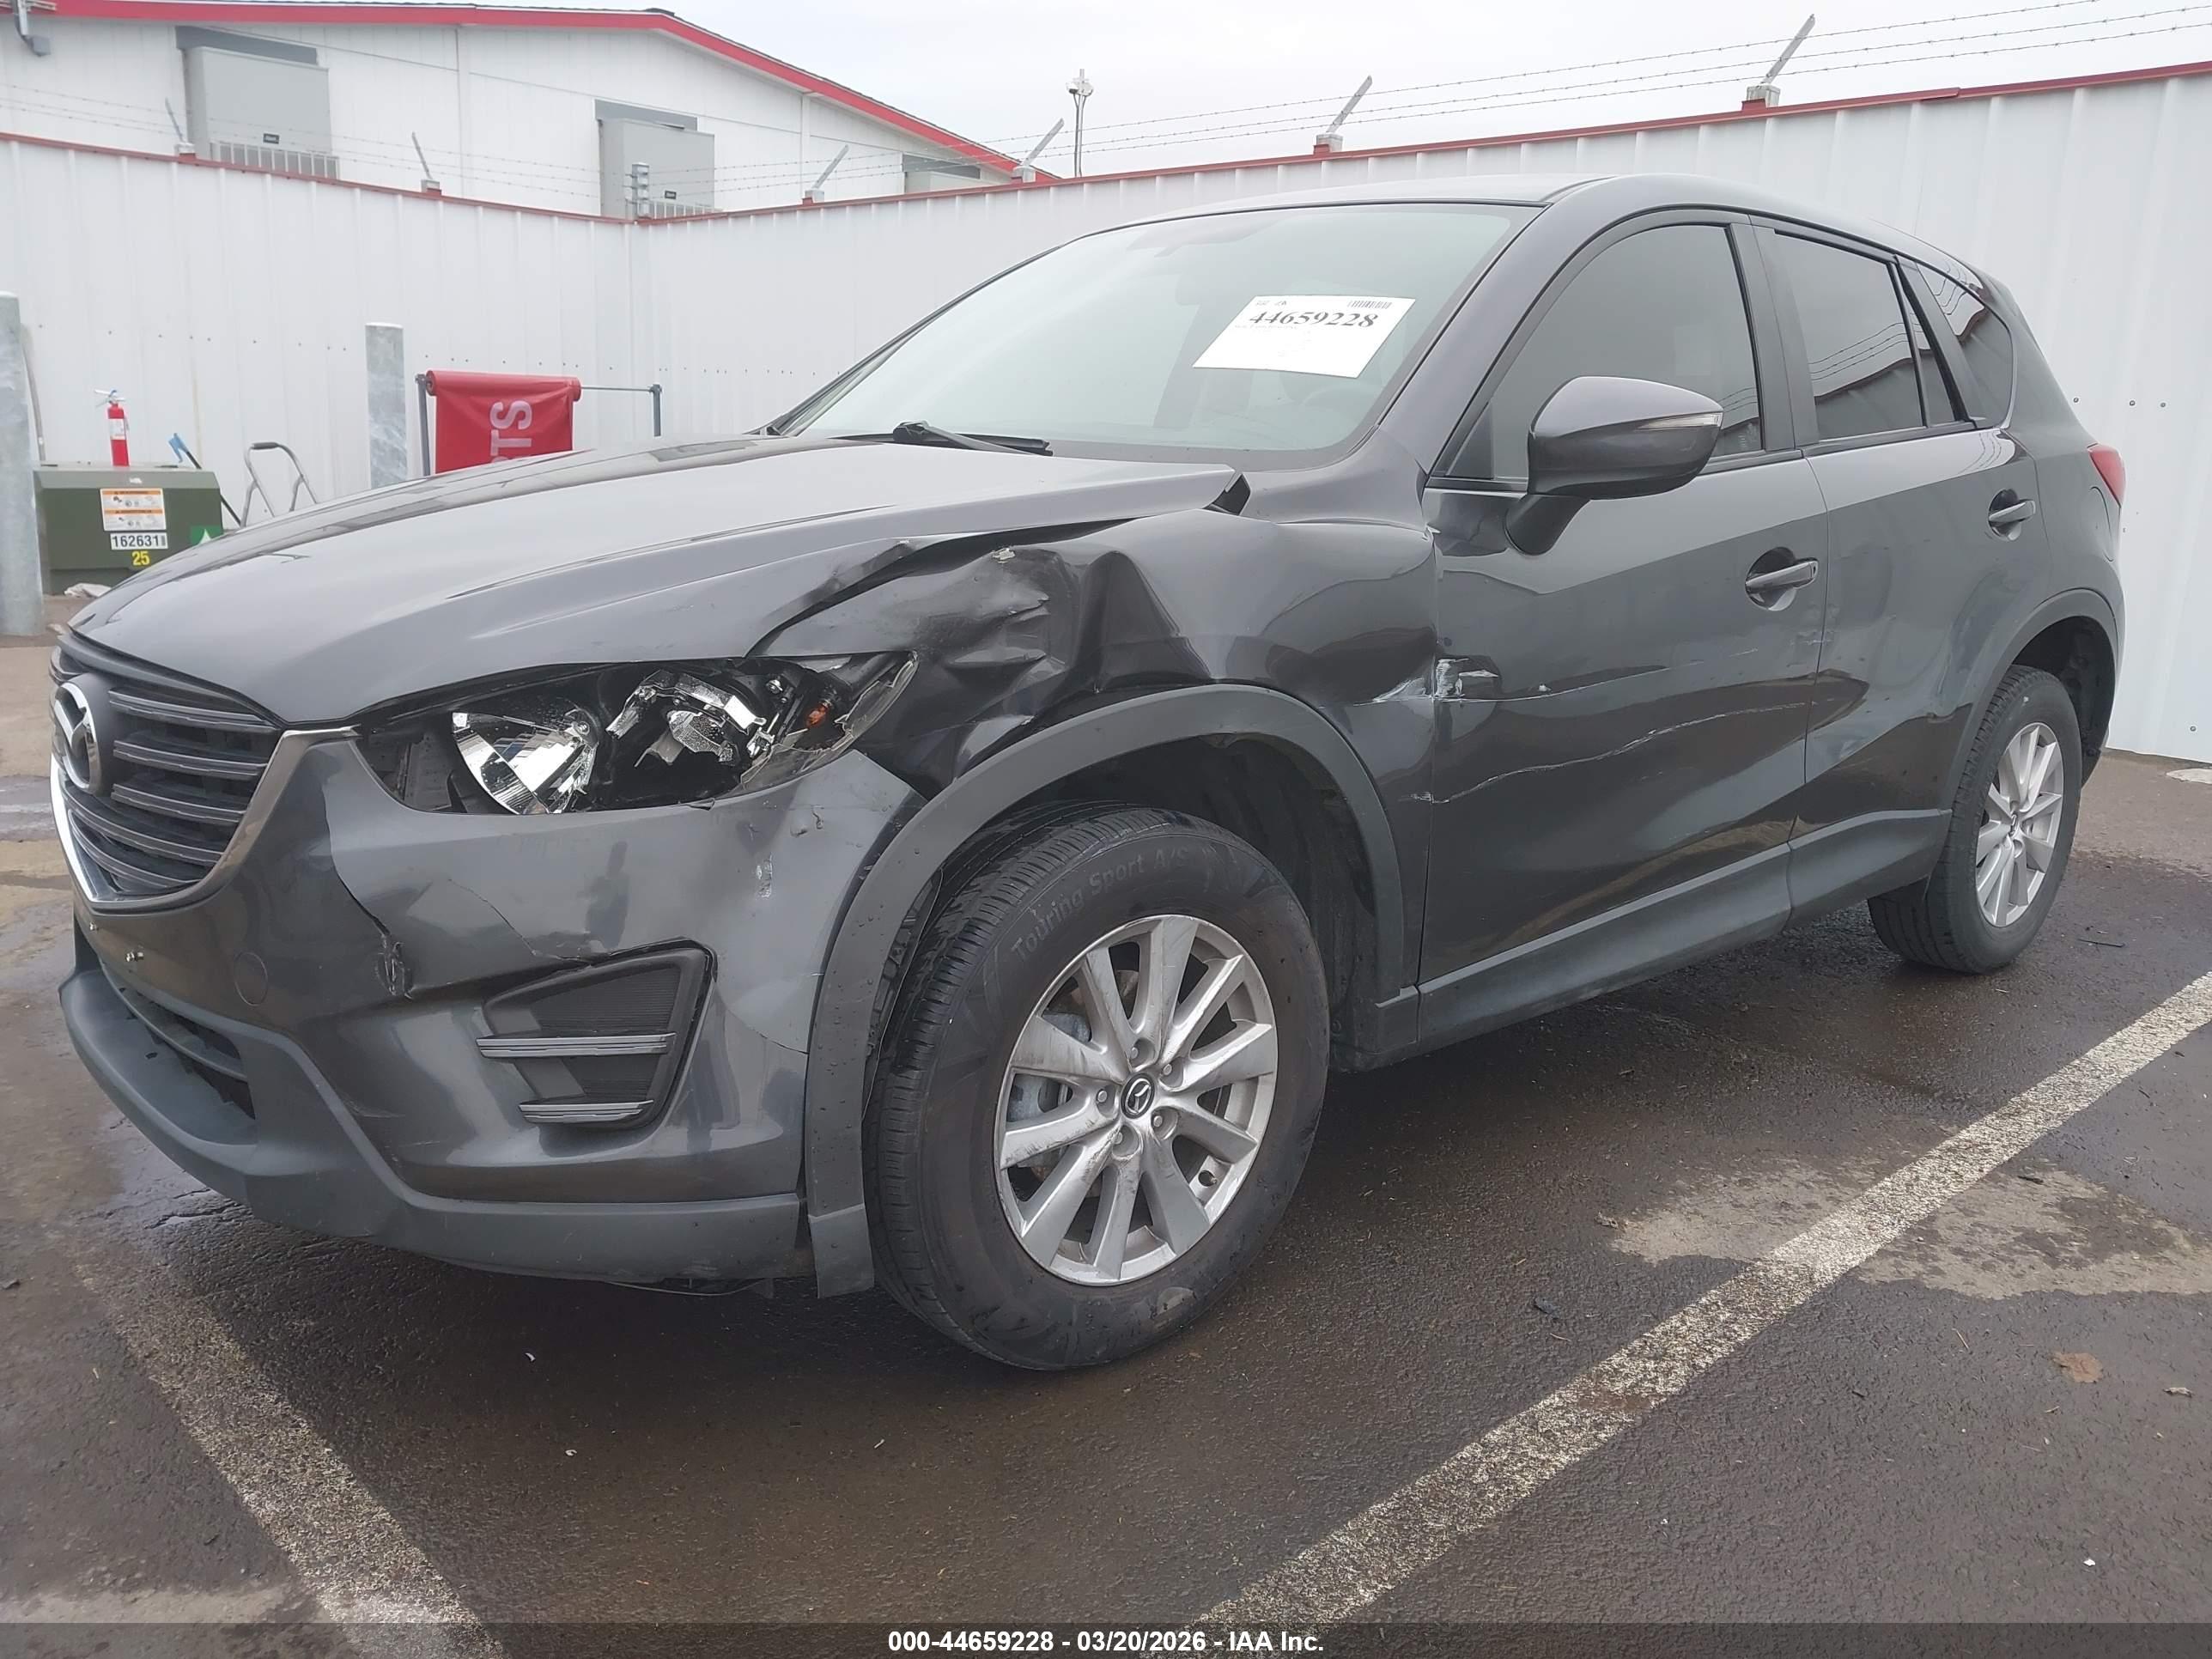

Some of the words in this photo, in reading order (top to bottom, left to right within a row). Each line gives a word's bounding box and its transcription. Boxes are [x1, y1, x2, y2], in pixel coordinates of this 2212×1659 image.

[1249, 311, 1379, 327] 44659228
[489, 400, 532, 464] TS
[112, 535, 159, 547] 162631
[131, 550, 150, 565] 25
[1012, 890, 1085, 961] Touring
[1087, 853, 1145, 896] Sport
